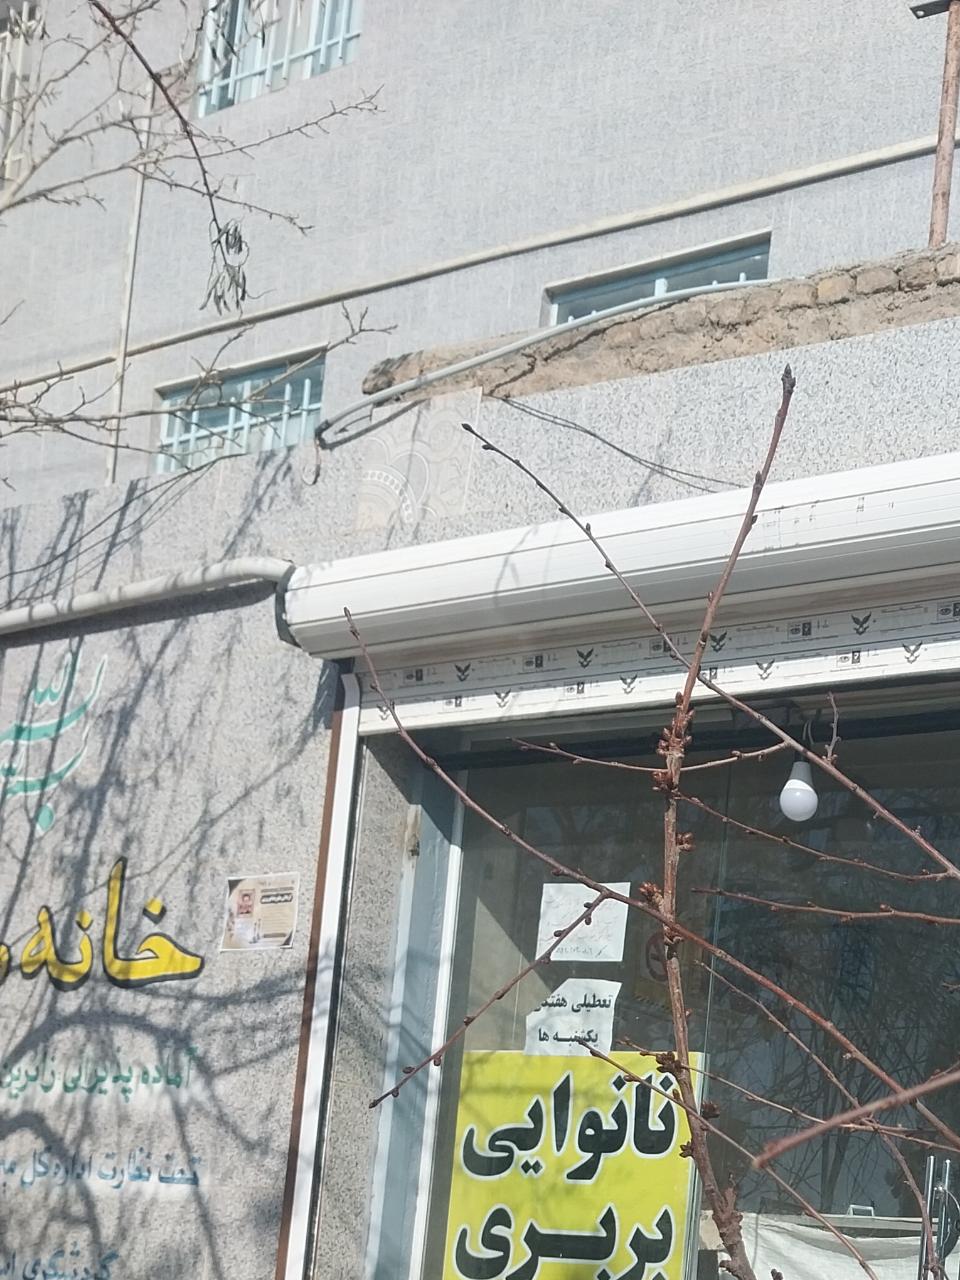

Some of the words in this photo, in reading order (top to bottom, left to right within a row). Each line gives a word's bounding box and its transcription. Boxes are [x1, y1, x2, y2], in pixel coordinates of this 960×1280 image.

[19, 856, 206, 992] خانه
[538, 1027, 550, 1042] ها
[462, 1071, 676, 1181] نانوایی
